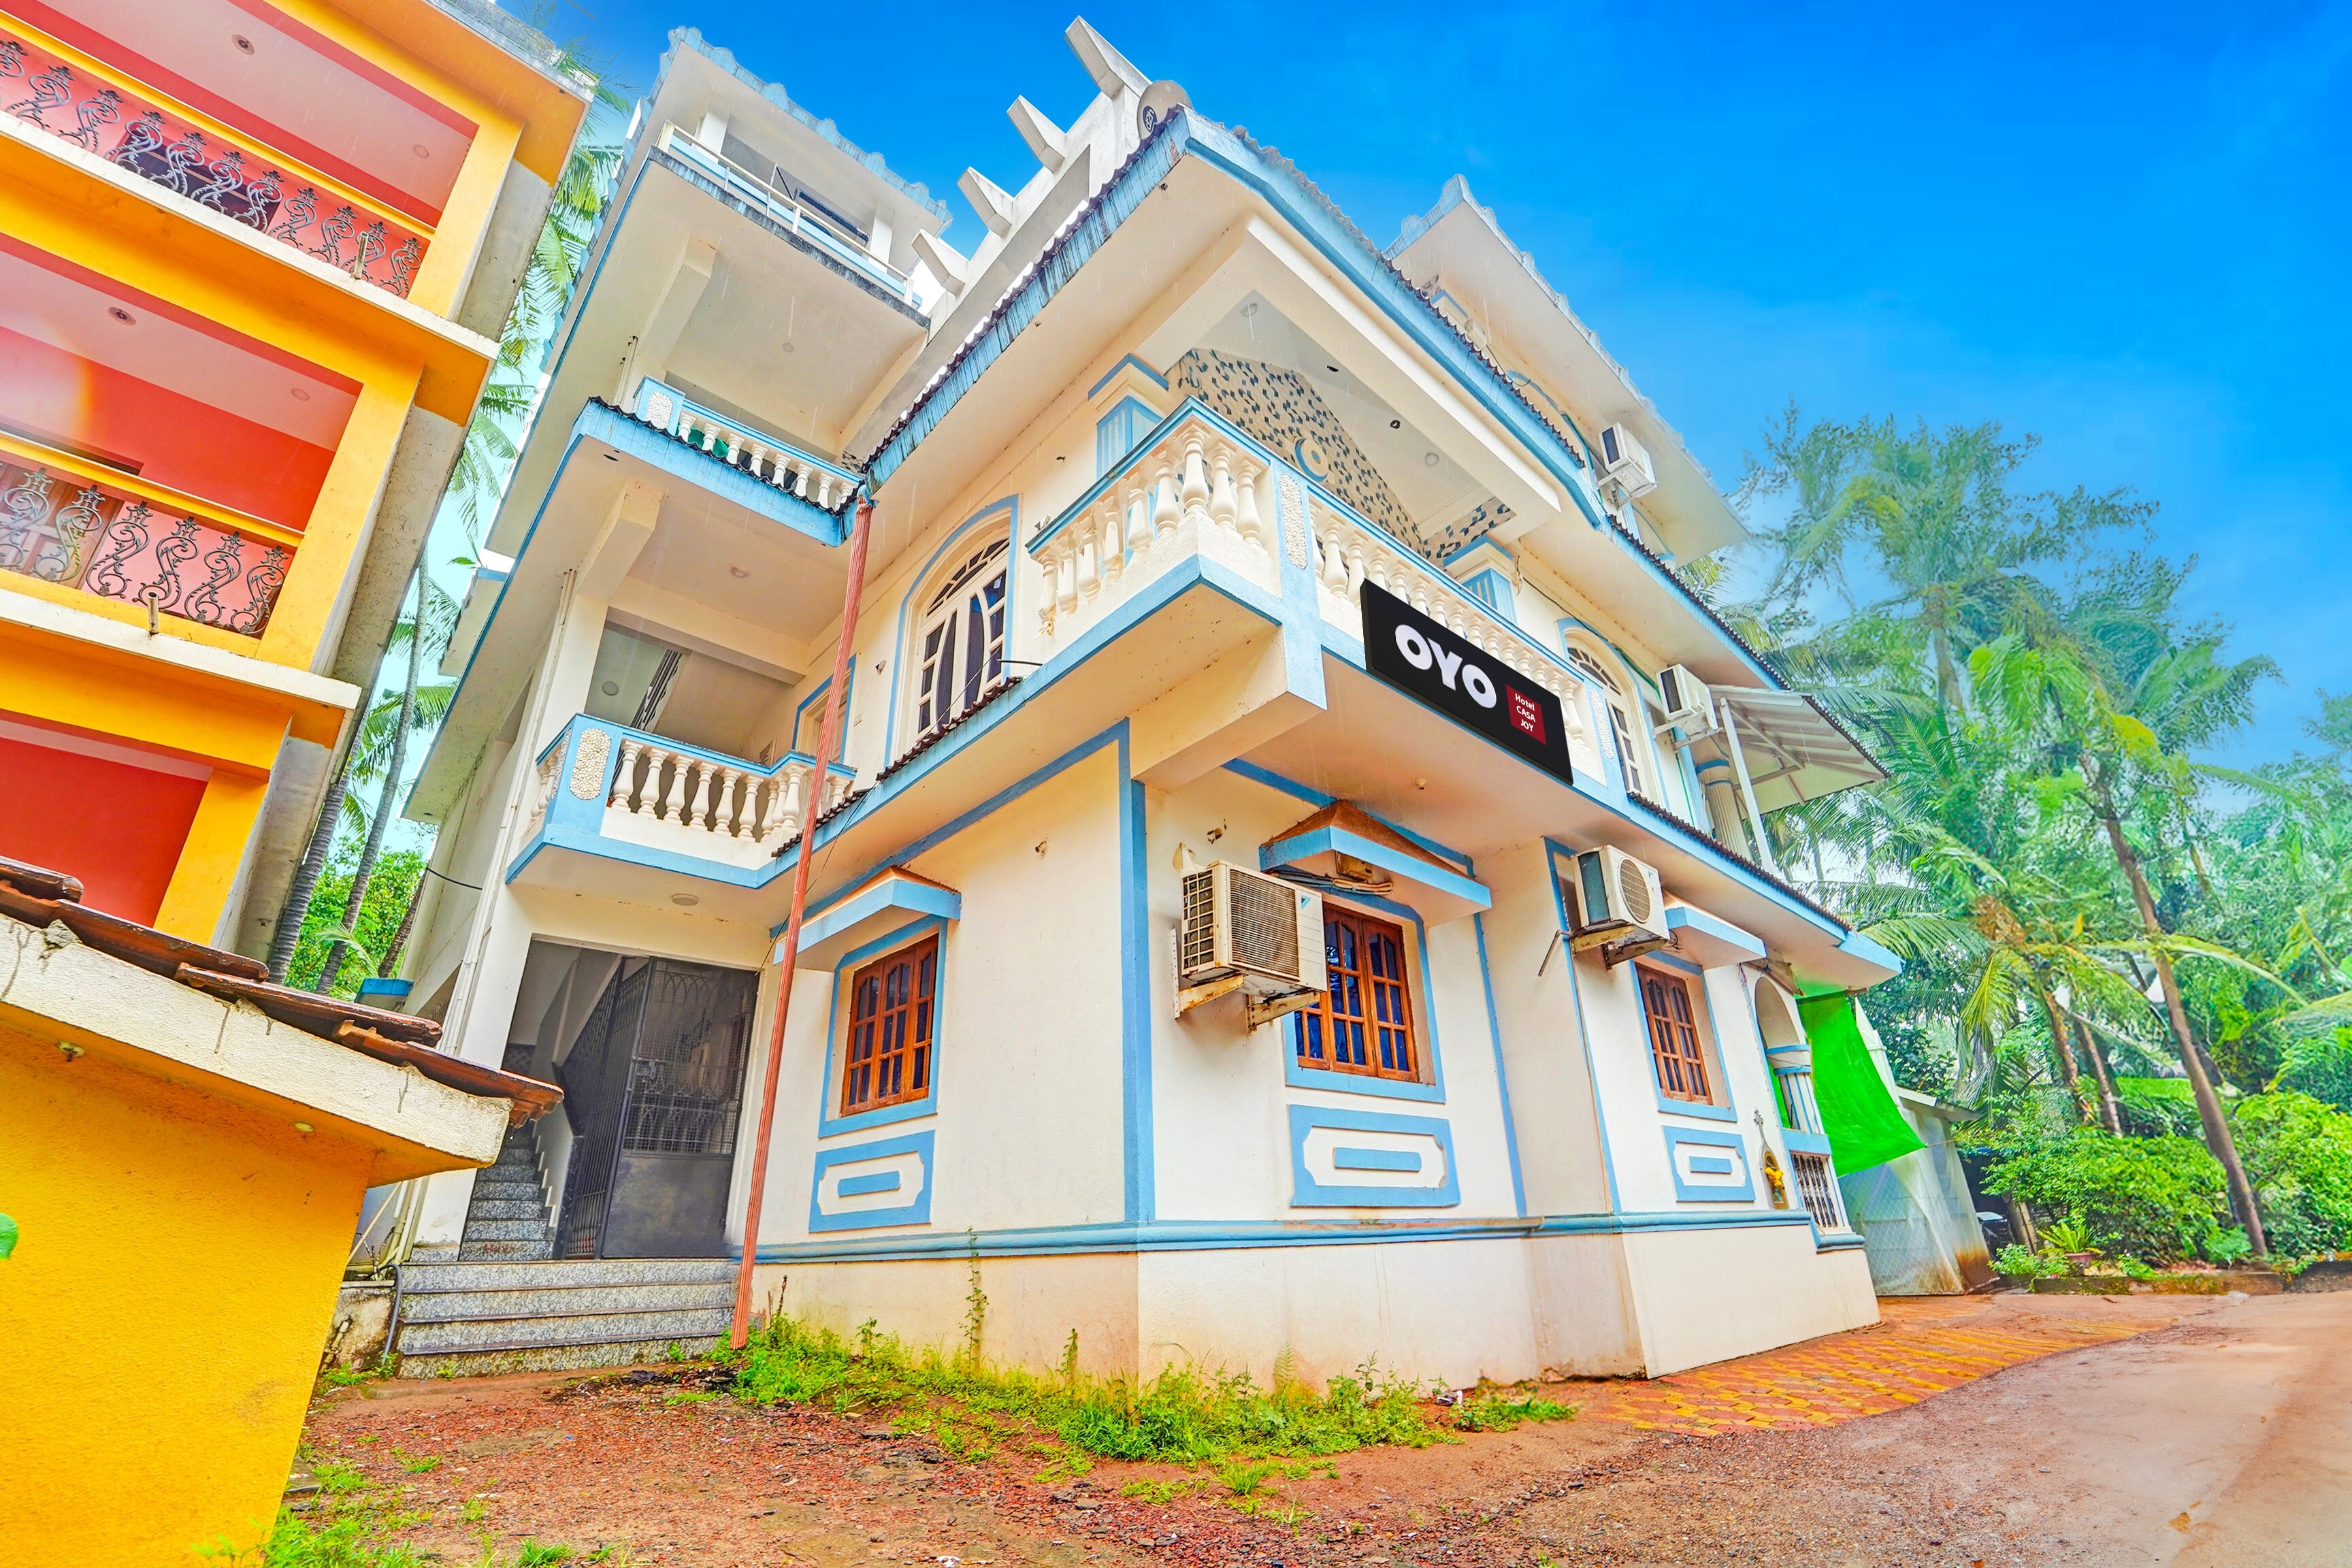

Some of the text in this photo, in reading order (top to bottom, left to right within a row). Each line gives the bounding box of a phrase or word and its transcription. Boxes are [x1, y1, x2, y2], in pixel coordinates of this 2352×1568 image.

[1394, 624, 1497, 709] OYO
[1514, 693, 1535, 711] Hotel
[1516, 705, 1536, 723] CASA
[1520, 719, 1534, 732] JOY
